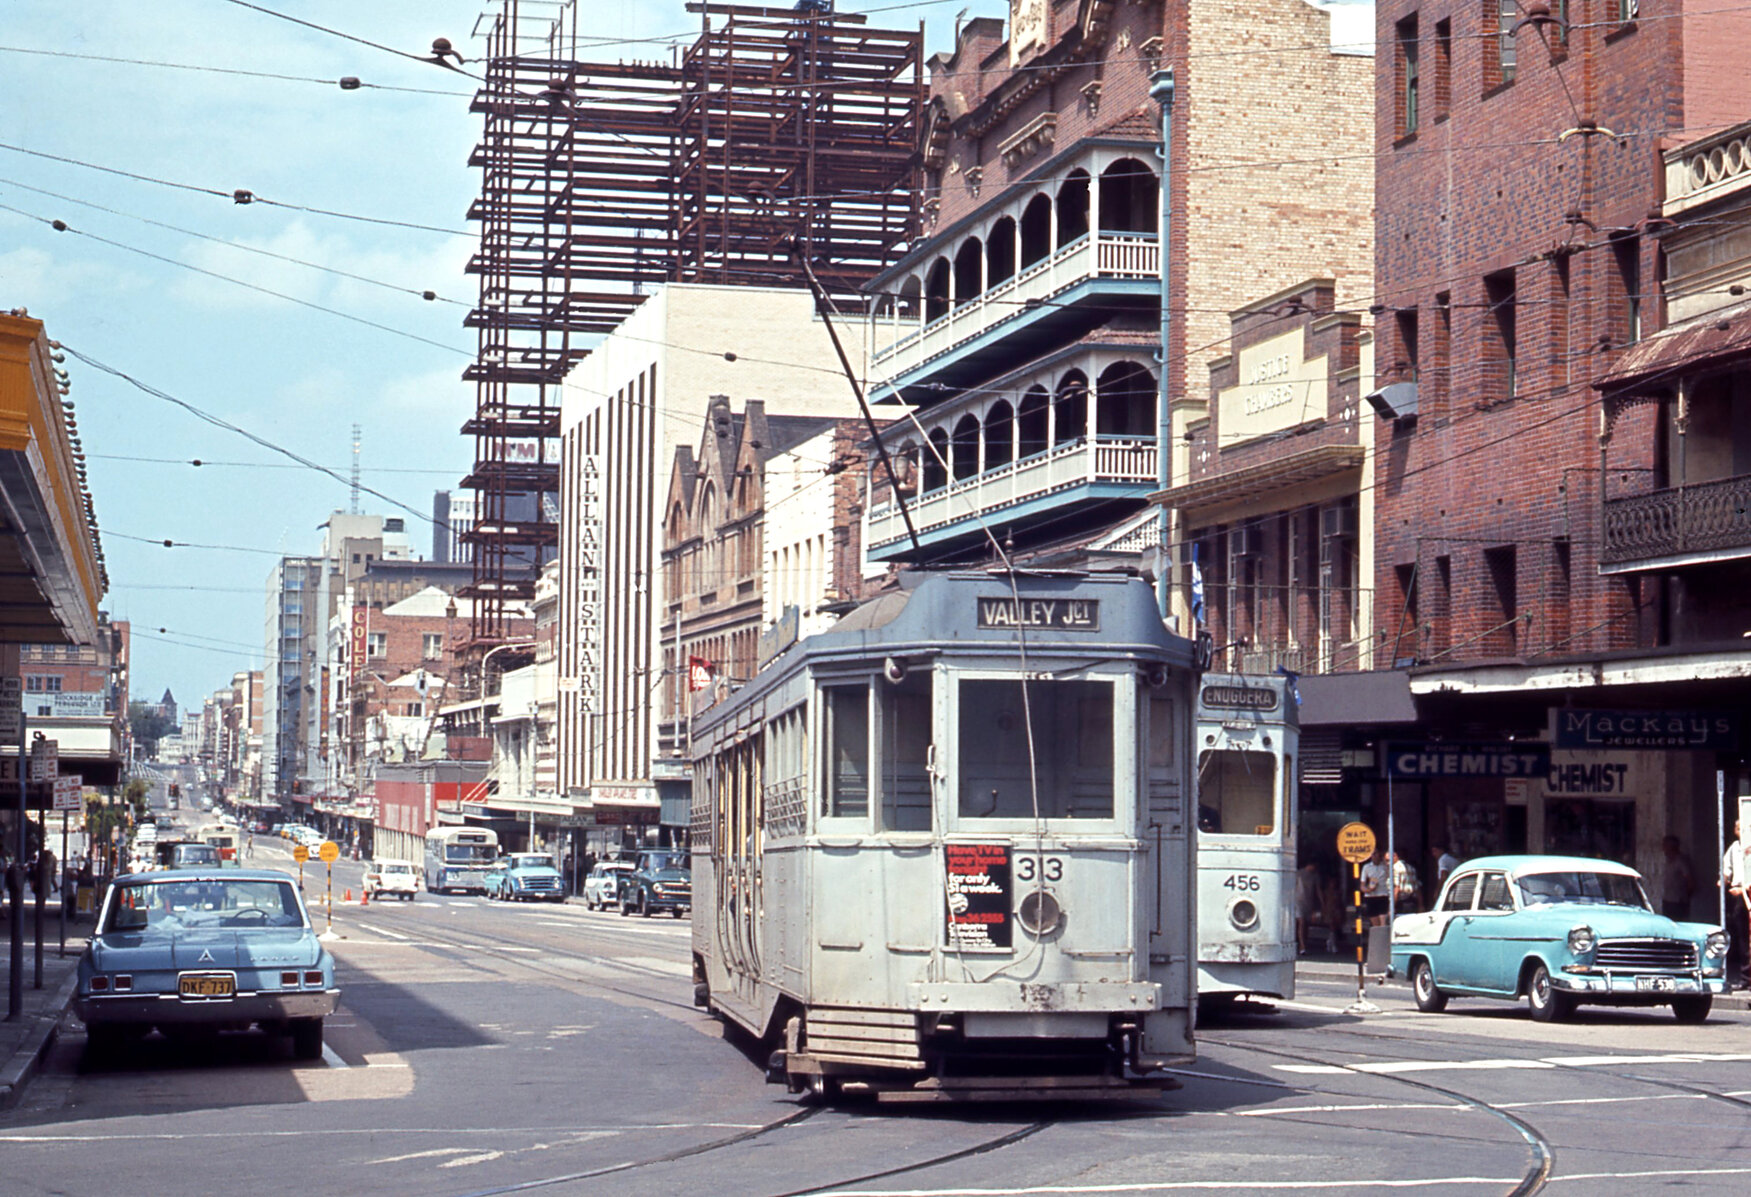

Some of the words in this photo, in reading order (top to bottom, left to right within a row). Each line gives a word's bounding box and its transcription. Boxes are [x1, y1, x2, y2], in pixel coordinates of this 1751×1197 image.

[582, 457, 597, 566] ALLAN
[983, 600, 1056, 626] VALLEY
[579, 603, 594, 713] STARK
[1205, 689, 1272, 705] ENUGGERA
[1566, 713, 1731, 743] Mackays
[1605, 736, 1687, 746] JEWELLERS
[1397, 754, 1538, 774] CHEMIST
[1547, 763, 1628, 793] CHEMIST
[1343, 845, 1371, 854] TRAMS
[965, 872, 991, 886] only
[1223, 874, 1261, 892] 456
[182, 980, 206, 993] DKF
[211, 979, 232, 993] 737
